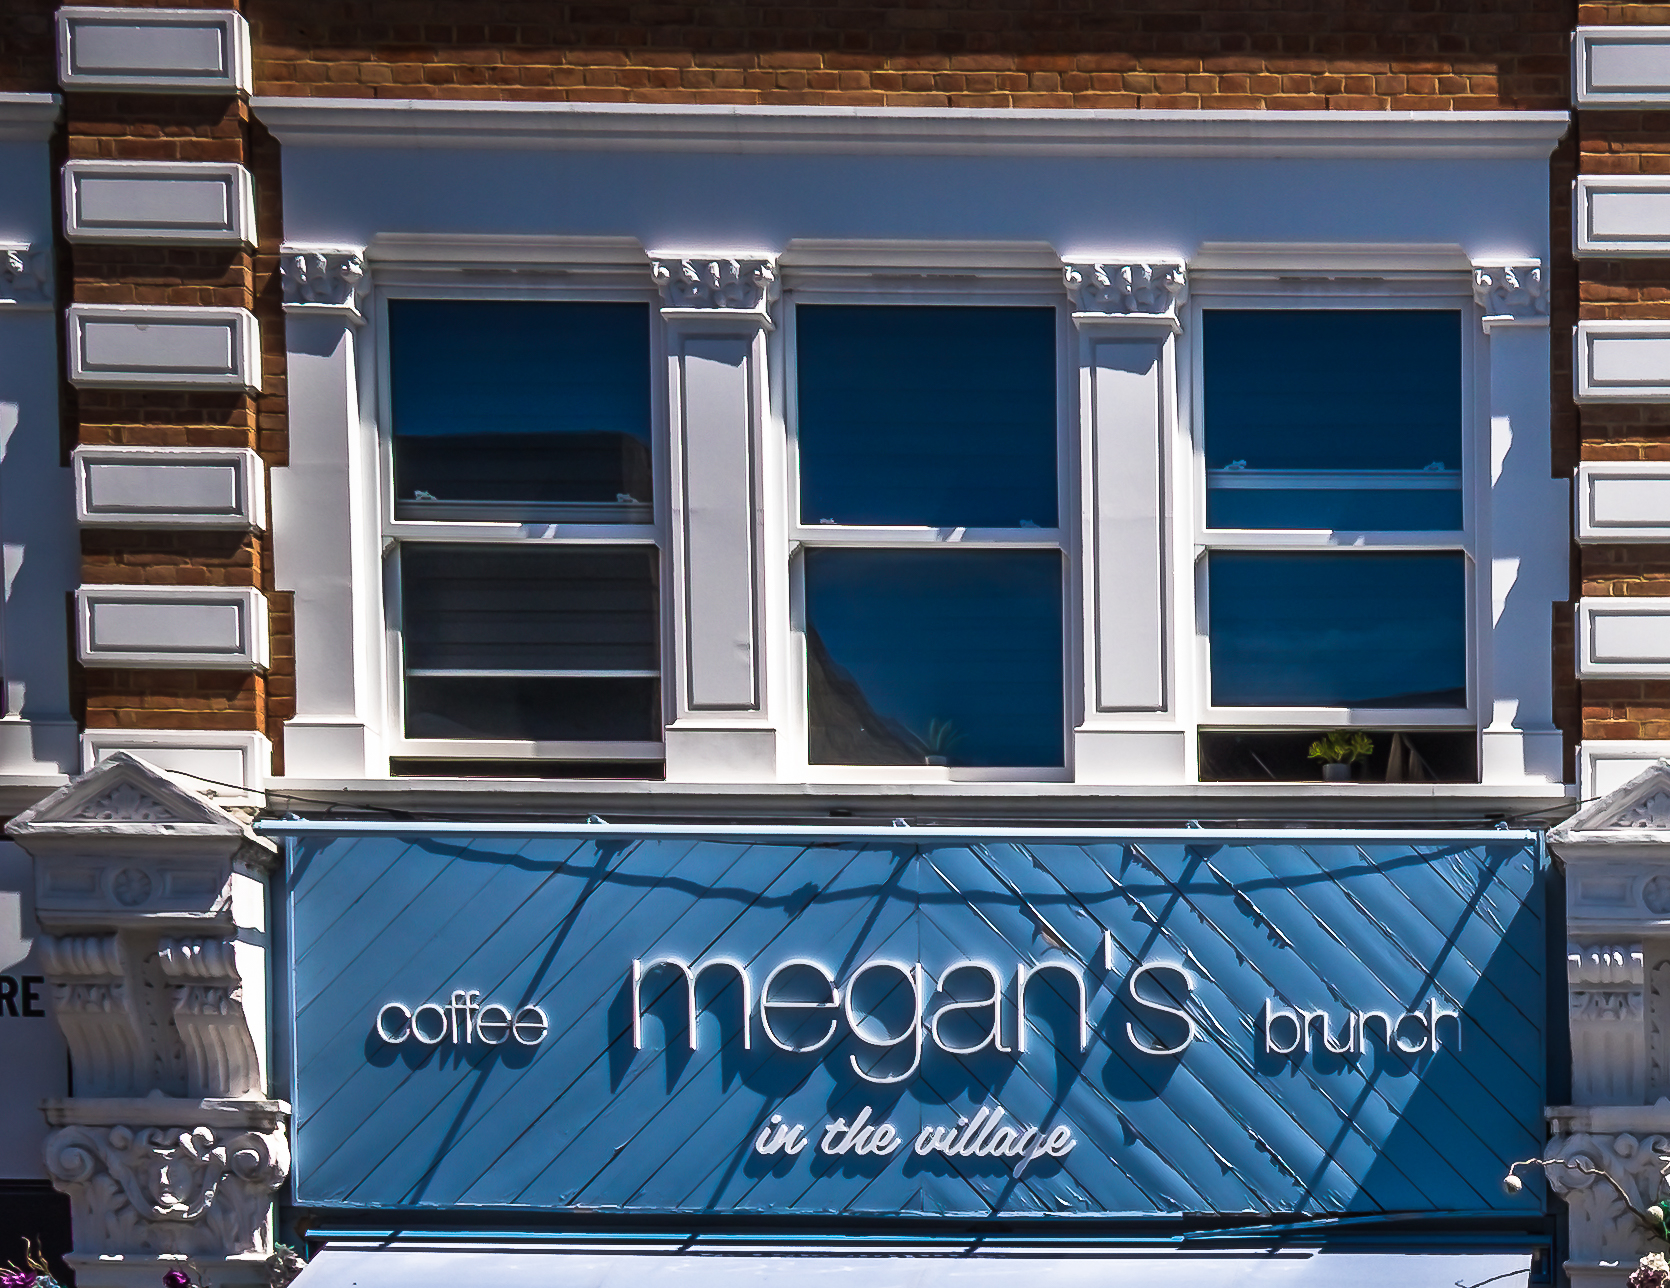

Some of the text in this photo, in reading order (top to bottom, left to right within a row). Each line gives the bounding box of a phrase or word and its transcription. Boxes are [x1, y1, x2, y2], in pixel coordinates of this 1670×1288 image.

[375, 989, 550, 1047] coffee
[632, 929, 1198, 1086] megan's
[1264, 996, 1463, 1055] brunch
[755, 1105, 1077, 1180] in the village
